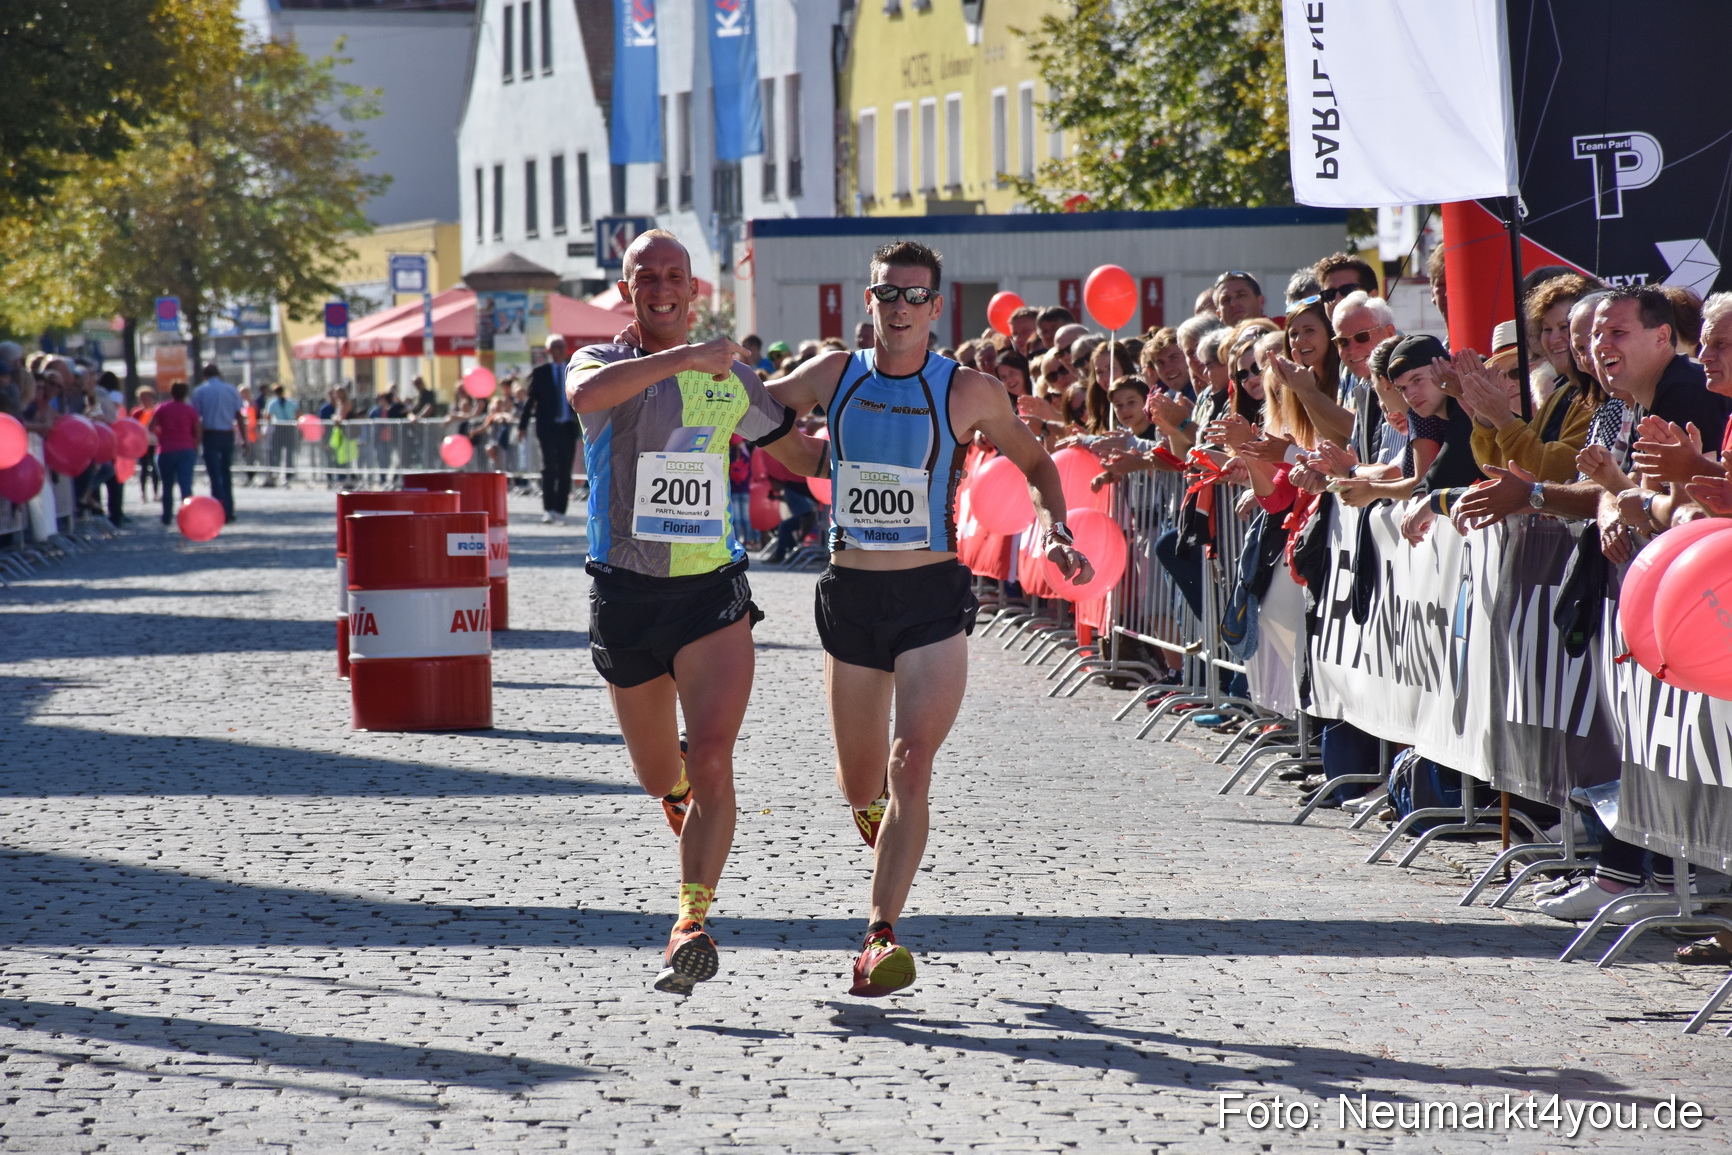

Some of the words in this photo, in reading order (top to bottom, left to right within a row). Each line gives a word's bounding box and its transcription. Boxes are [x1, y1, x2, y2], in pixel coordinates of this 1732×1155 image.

[1579, 142, 1607, 151] Team
[666, 461, 704, 472] BOCK
[860, 471, 900, 482] BOCK
[650, 477, 711, 506] 2001
[848, 487, 914, 515] 2000
[663, 521, 700, 534] Florian
[864, 530, 899, 541] Marco
